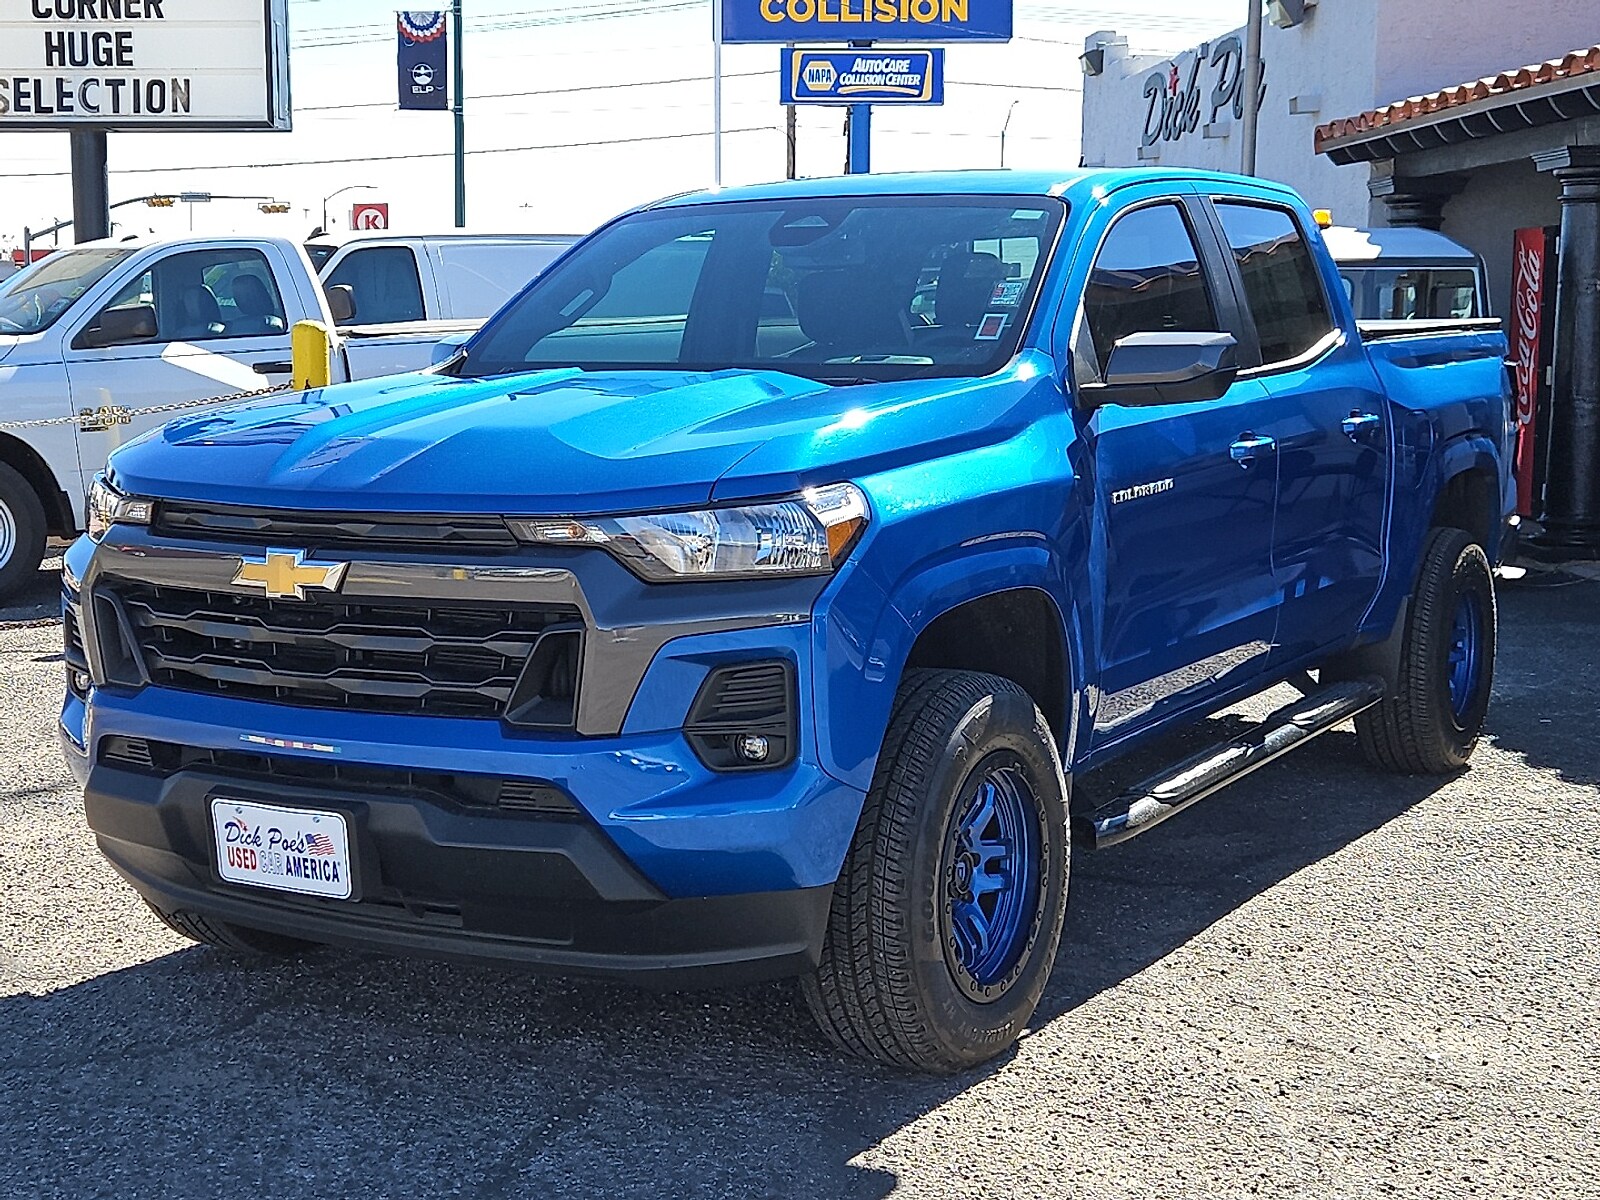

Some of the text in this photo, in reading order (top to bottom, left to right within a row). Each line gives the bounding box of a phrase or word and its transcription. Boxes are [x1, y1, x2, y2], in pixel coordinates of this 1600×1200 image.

[32, 0, 164, 19] CORNER
[760, 0, 969, 23] COLLISION
[44, 31, 134, 67] HUGE
[808, 68, 833, 84] NAPA
[839, 73, 921, 86] COLLISION CENTER
[0, 77, 191, 114] SELECTION
[412, 85, 434, 94] ELP
[1141, 51, 1200, 146] Dick
[364, 214, 380, 230] K
[1112, 478, 1174, 505] COLORADO
[224, 821, 306, 853] Dick Poe's
[227, 845, 340, 883] USED CAR AMERICA
